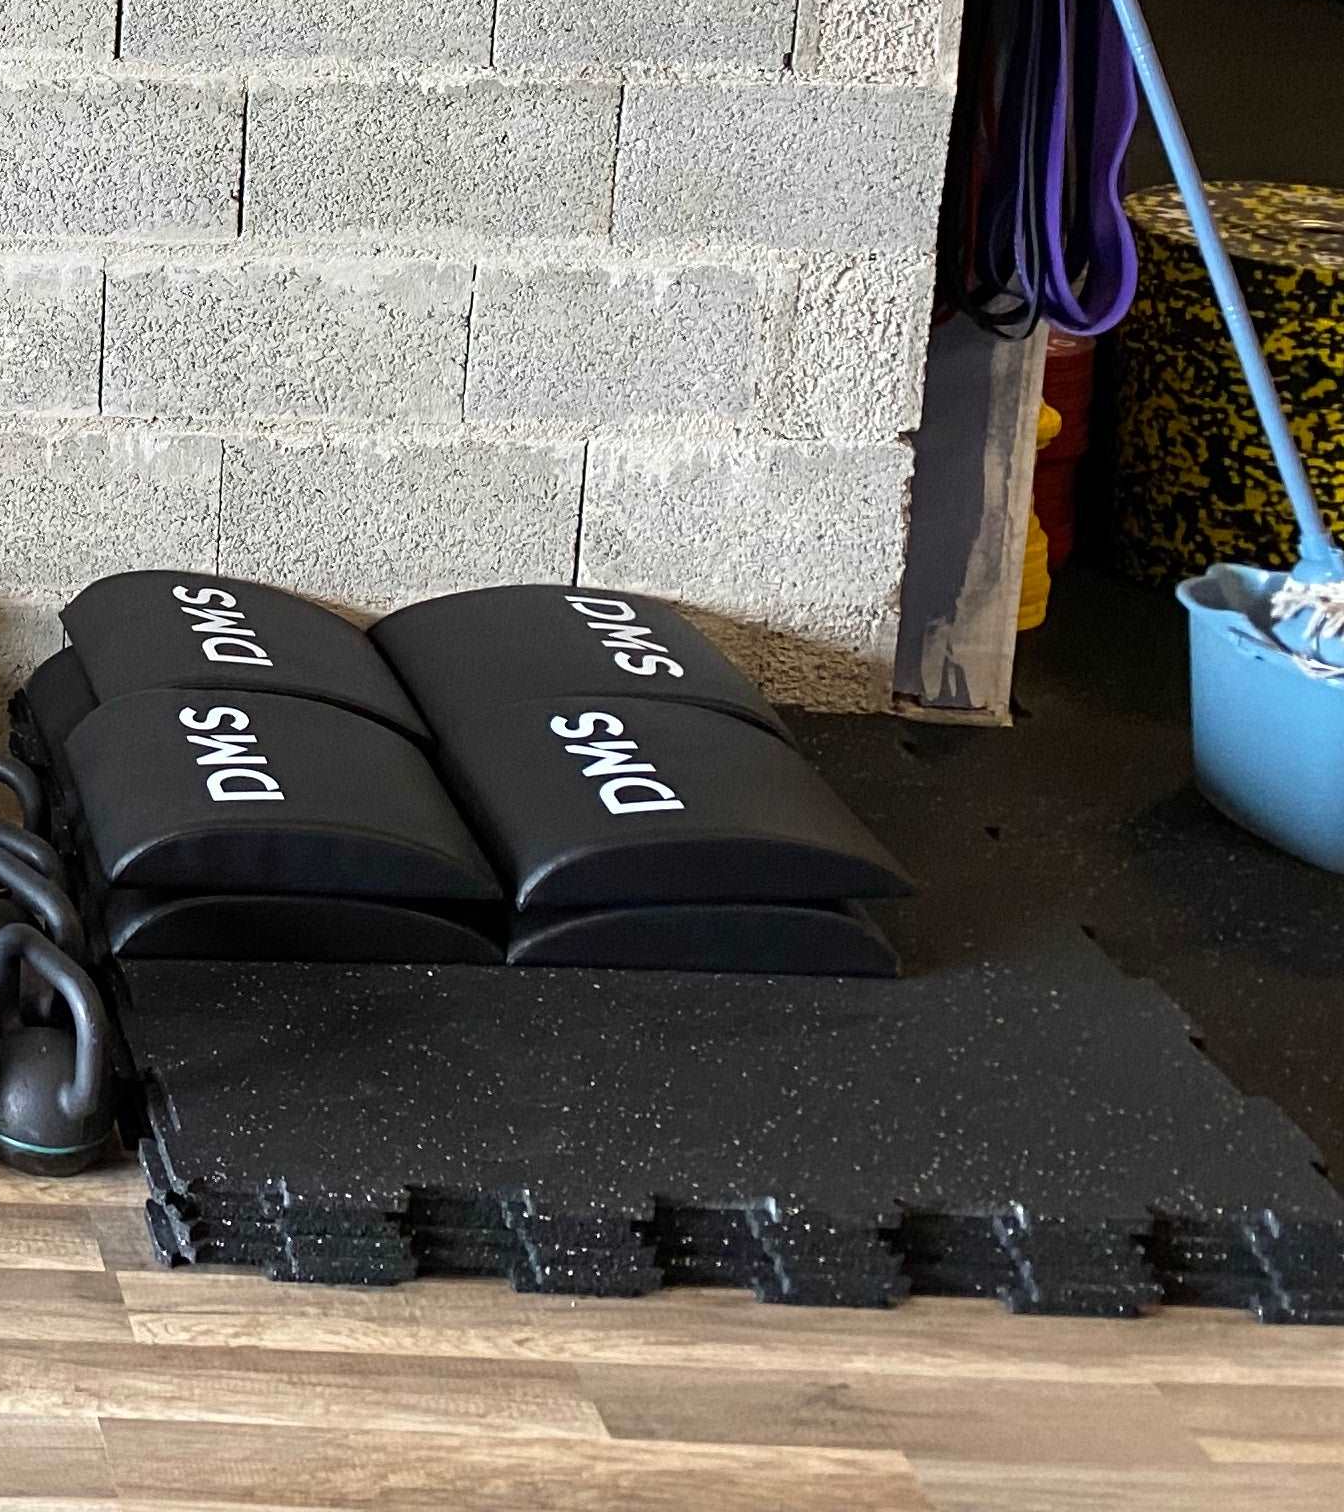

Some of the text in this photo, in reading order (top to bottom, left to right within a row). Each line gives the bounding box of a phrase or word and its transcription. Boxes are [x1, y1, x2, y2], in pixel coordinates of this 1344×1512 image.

[172, 585, 274, 667] DMS
[565, 595, 684, 678] DMS
[179, 706, 285, 801] DMS
[550, 711, 685, 815] DMS
